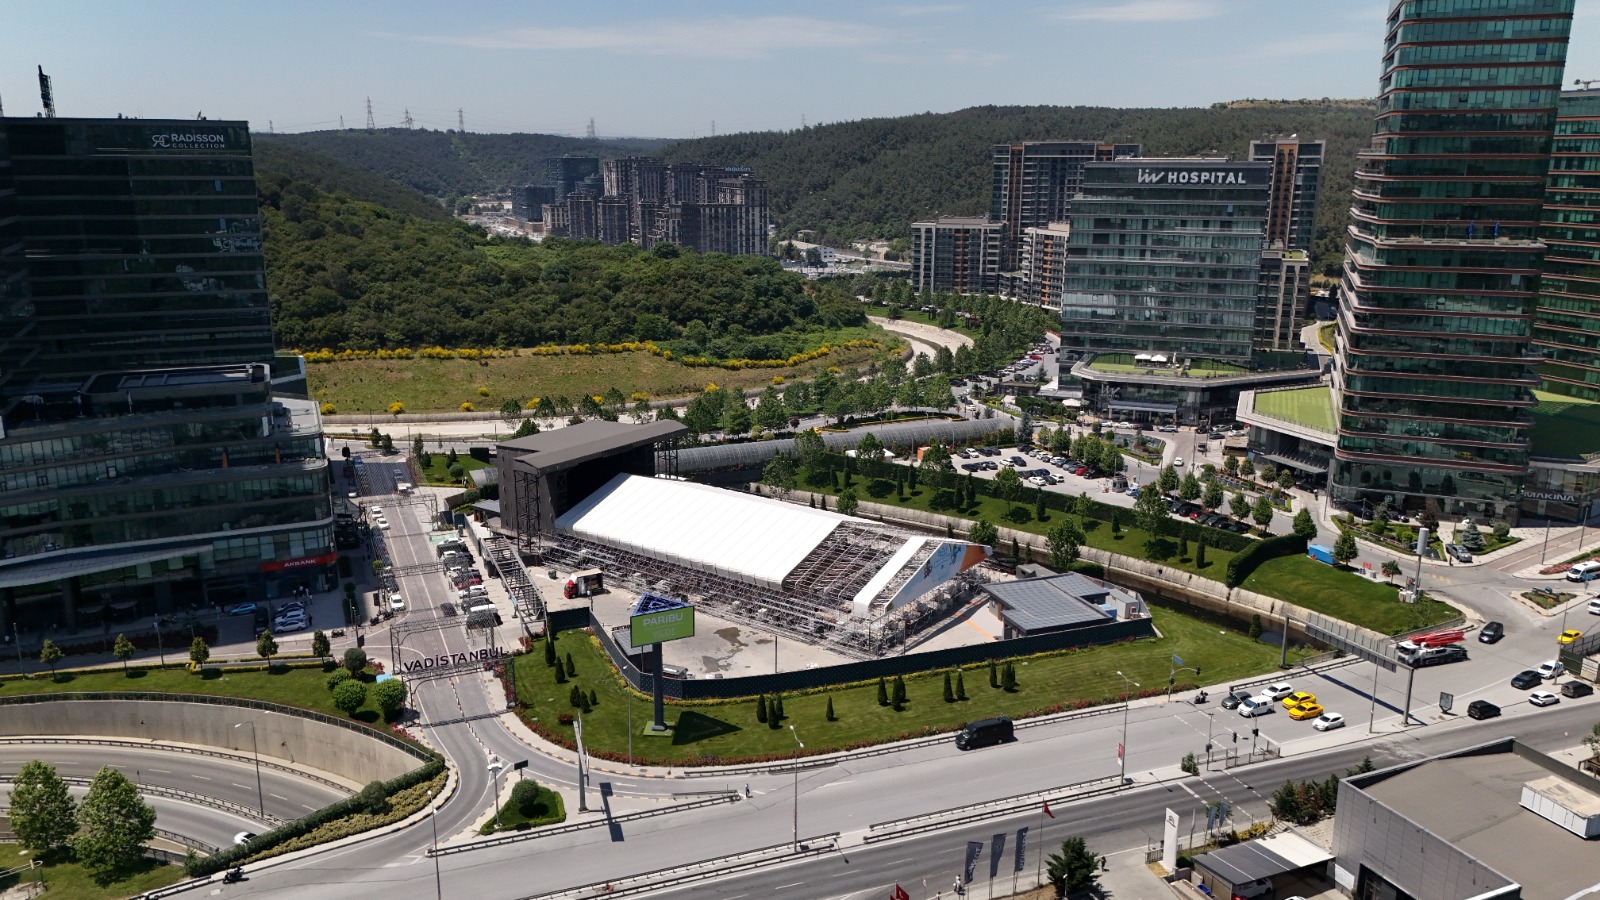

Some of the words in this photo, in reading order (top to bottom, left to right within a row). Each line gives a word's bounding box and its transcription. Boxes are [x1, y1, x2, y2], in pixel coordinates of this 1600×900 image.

[171, 133, 224, 142] RADISSON
[1167, 171, 1246, 184] HOSPITAL
[284, 559, 316, 568] AKBANK
[403, 646, 508, 672] VADİSTANBUL
